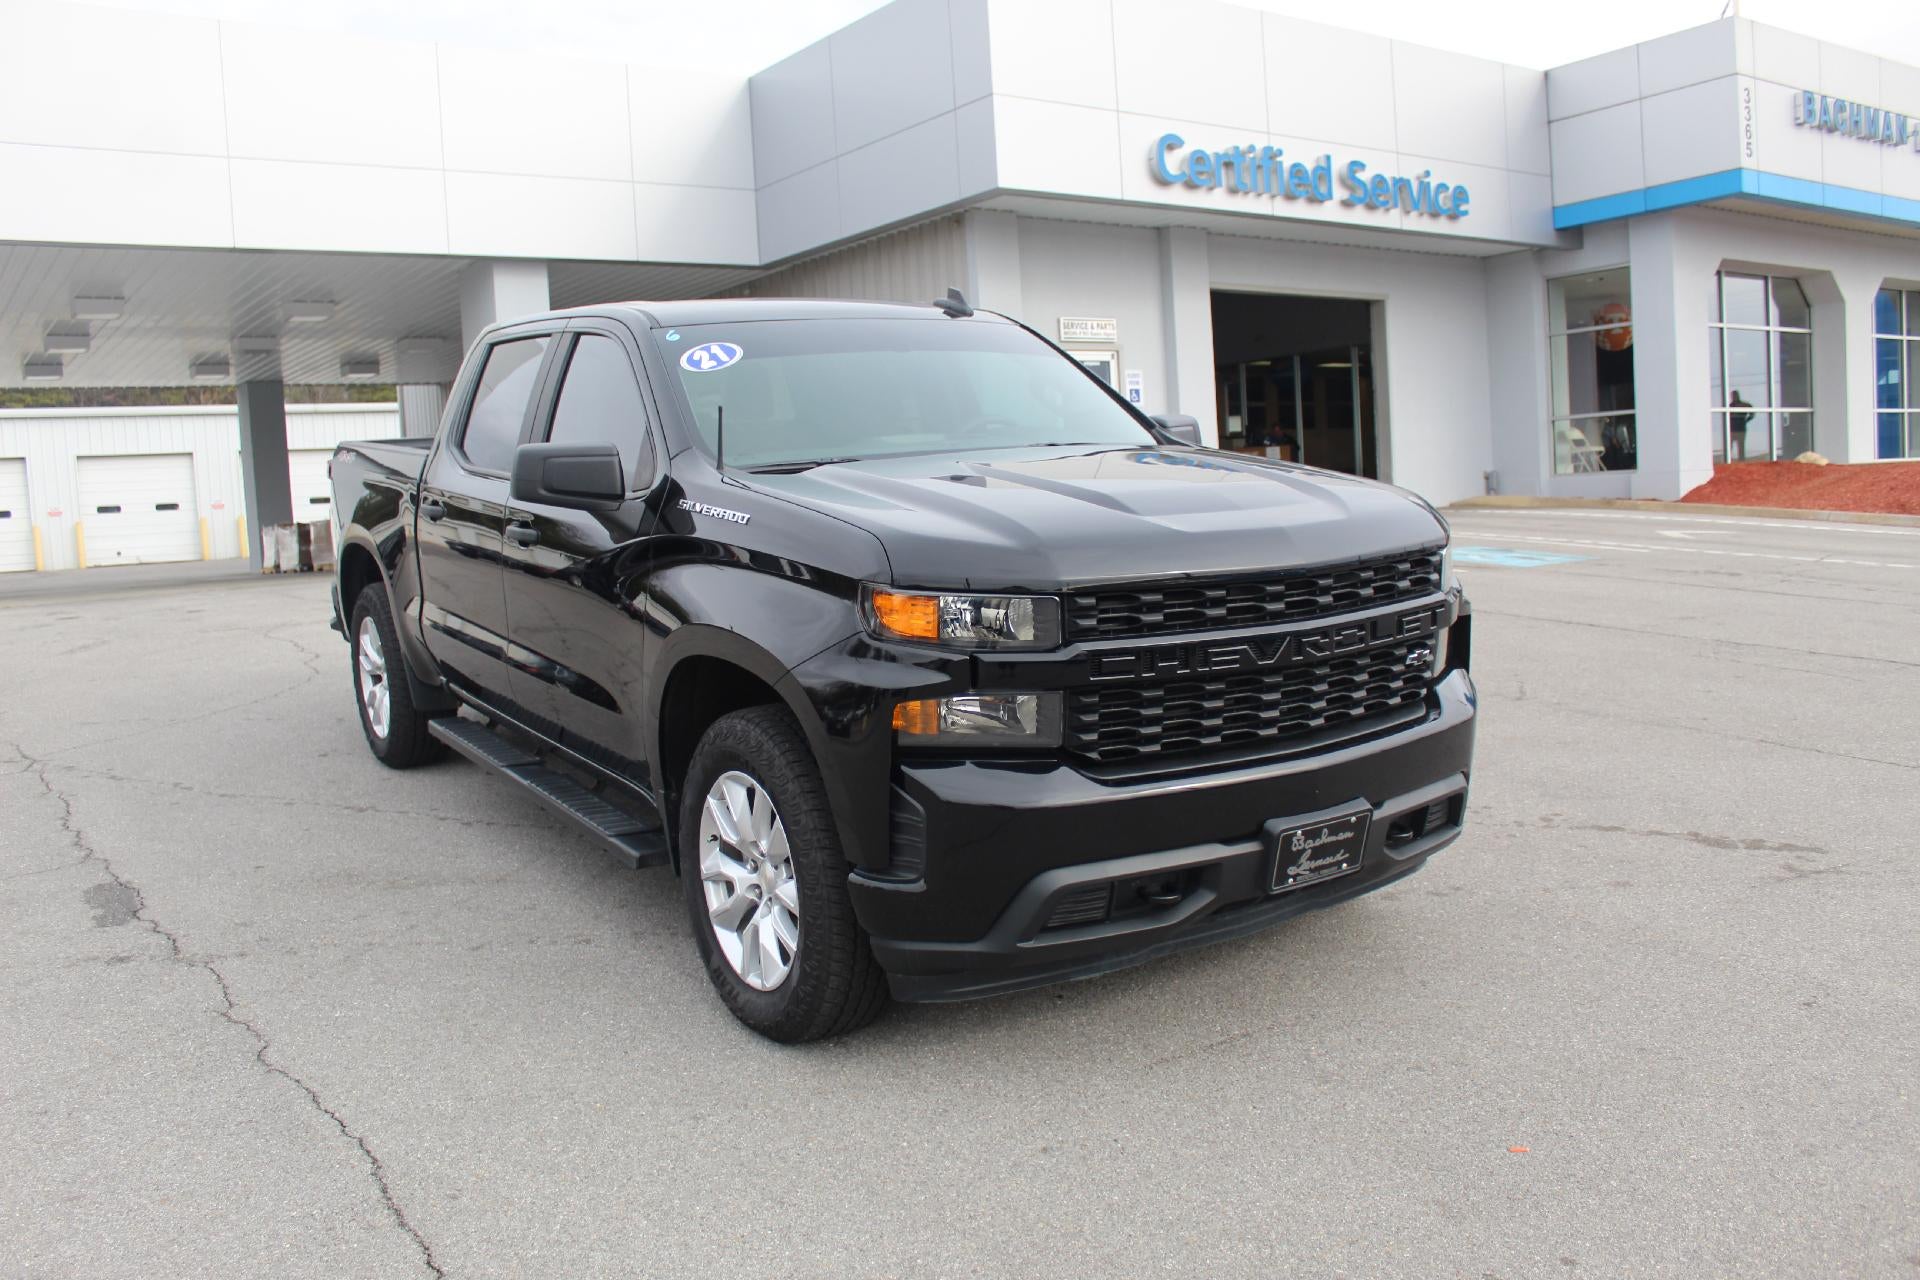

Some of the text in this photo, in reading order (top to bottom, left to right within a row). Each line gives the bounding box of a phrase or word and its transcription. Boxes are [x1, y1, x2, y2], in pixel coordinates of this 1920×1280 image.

[1151, 133, 1470, 218] Certified Service
[1063, 321, 1088, 330] SERVICE
[692, 344, 731, 370] 21
[677, 499, 751, 524] SILVERADO
[1089, 607, 1446, 681] CHEVROLET
